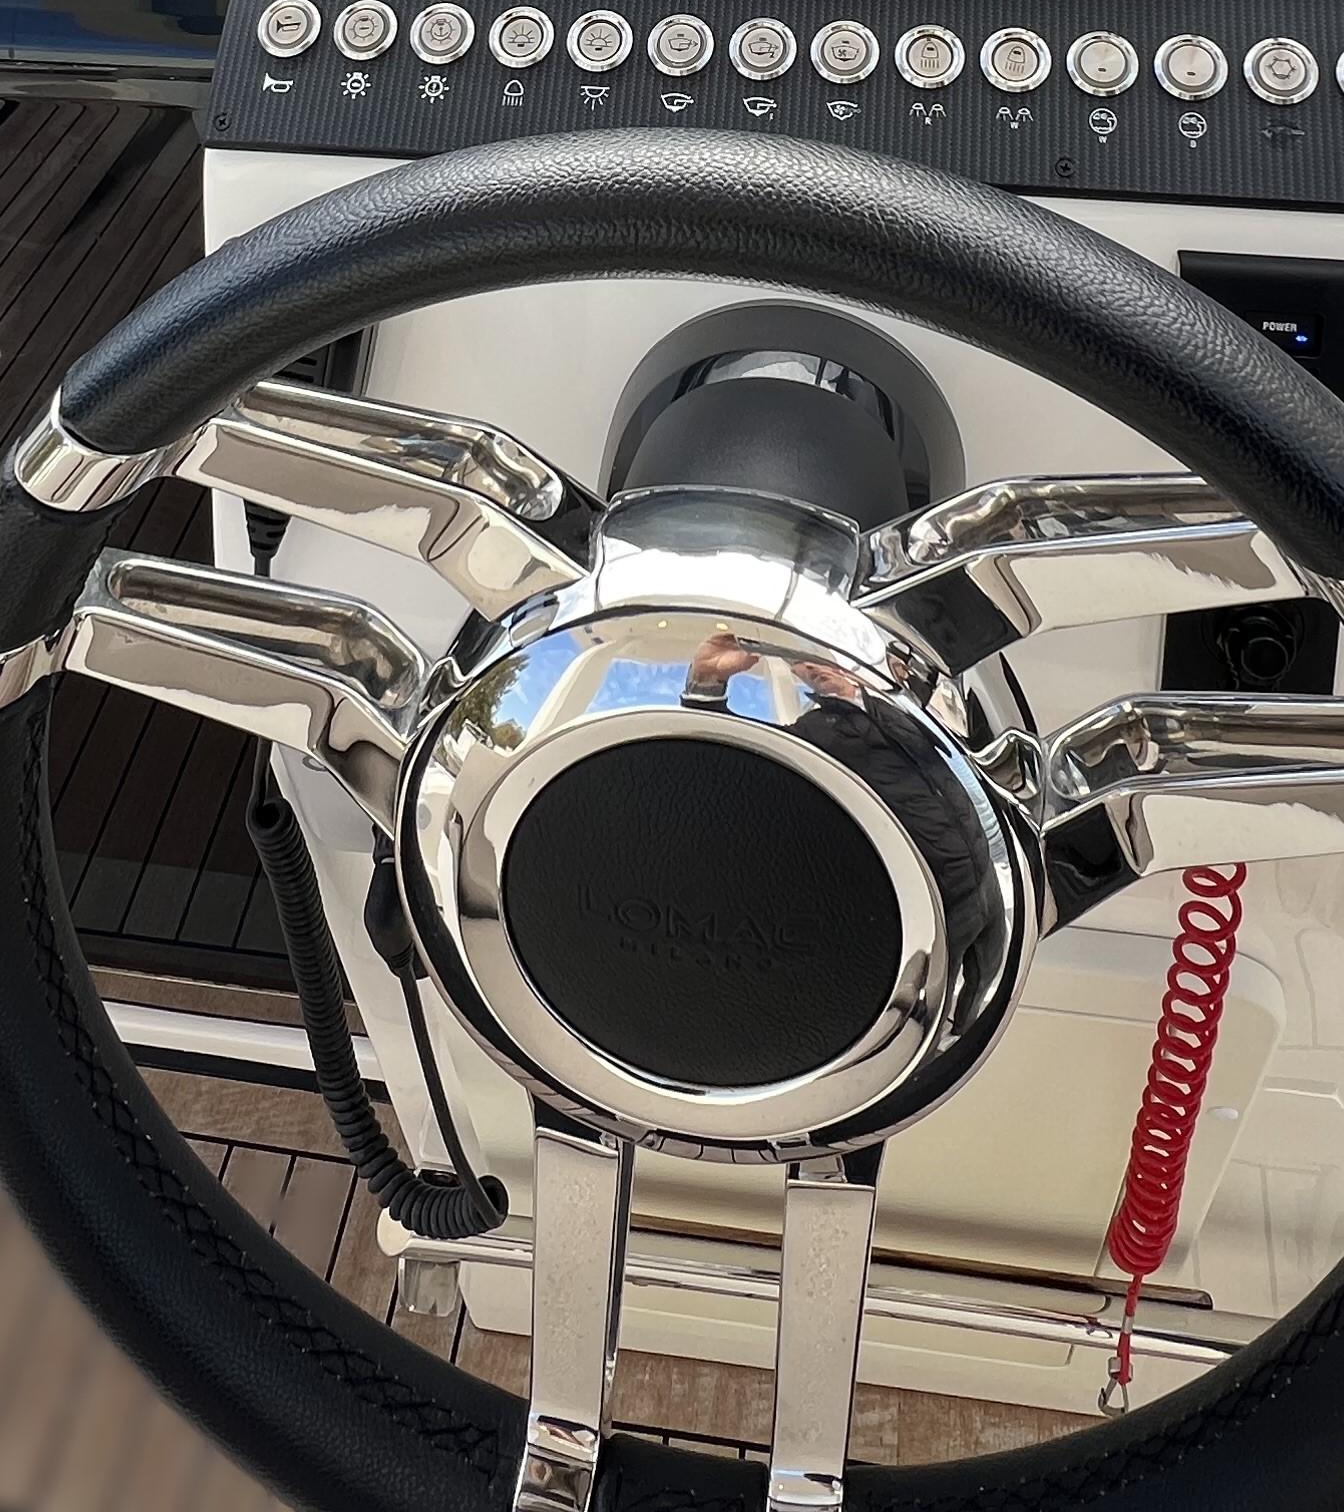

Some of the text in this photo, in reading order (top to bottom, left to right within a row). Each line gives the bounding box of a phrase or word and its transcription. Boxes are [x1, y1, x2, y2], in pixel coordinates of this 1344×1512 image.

[1010, 121, 1019, 129] W
[1261, 320, 1298, 333] POWER
[576, 882, 826, 954] LOMAC
